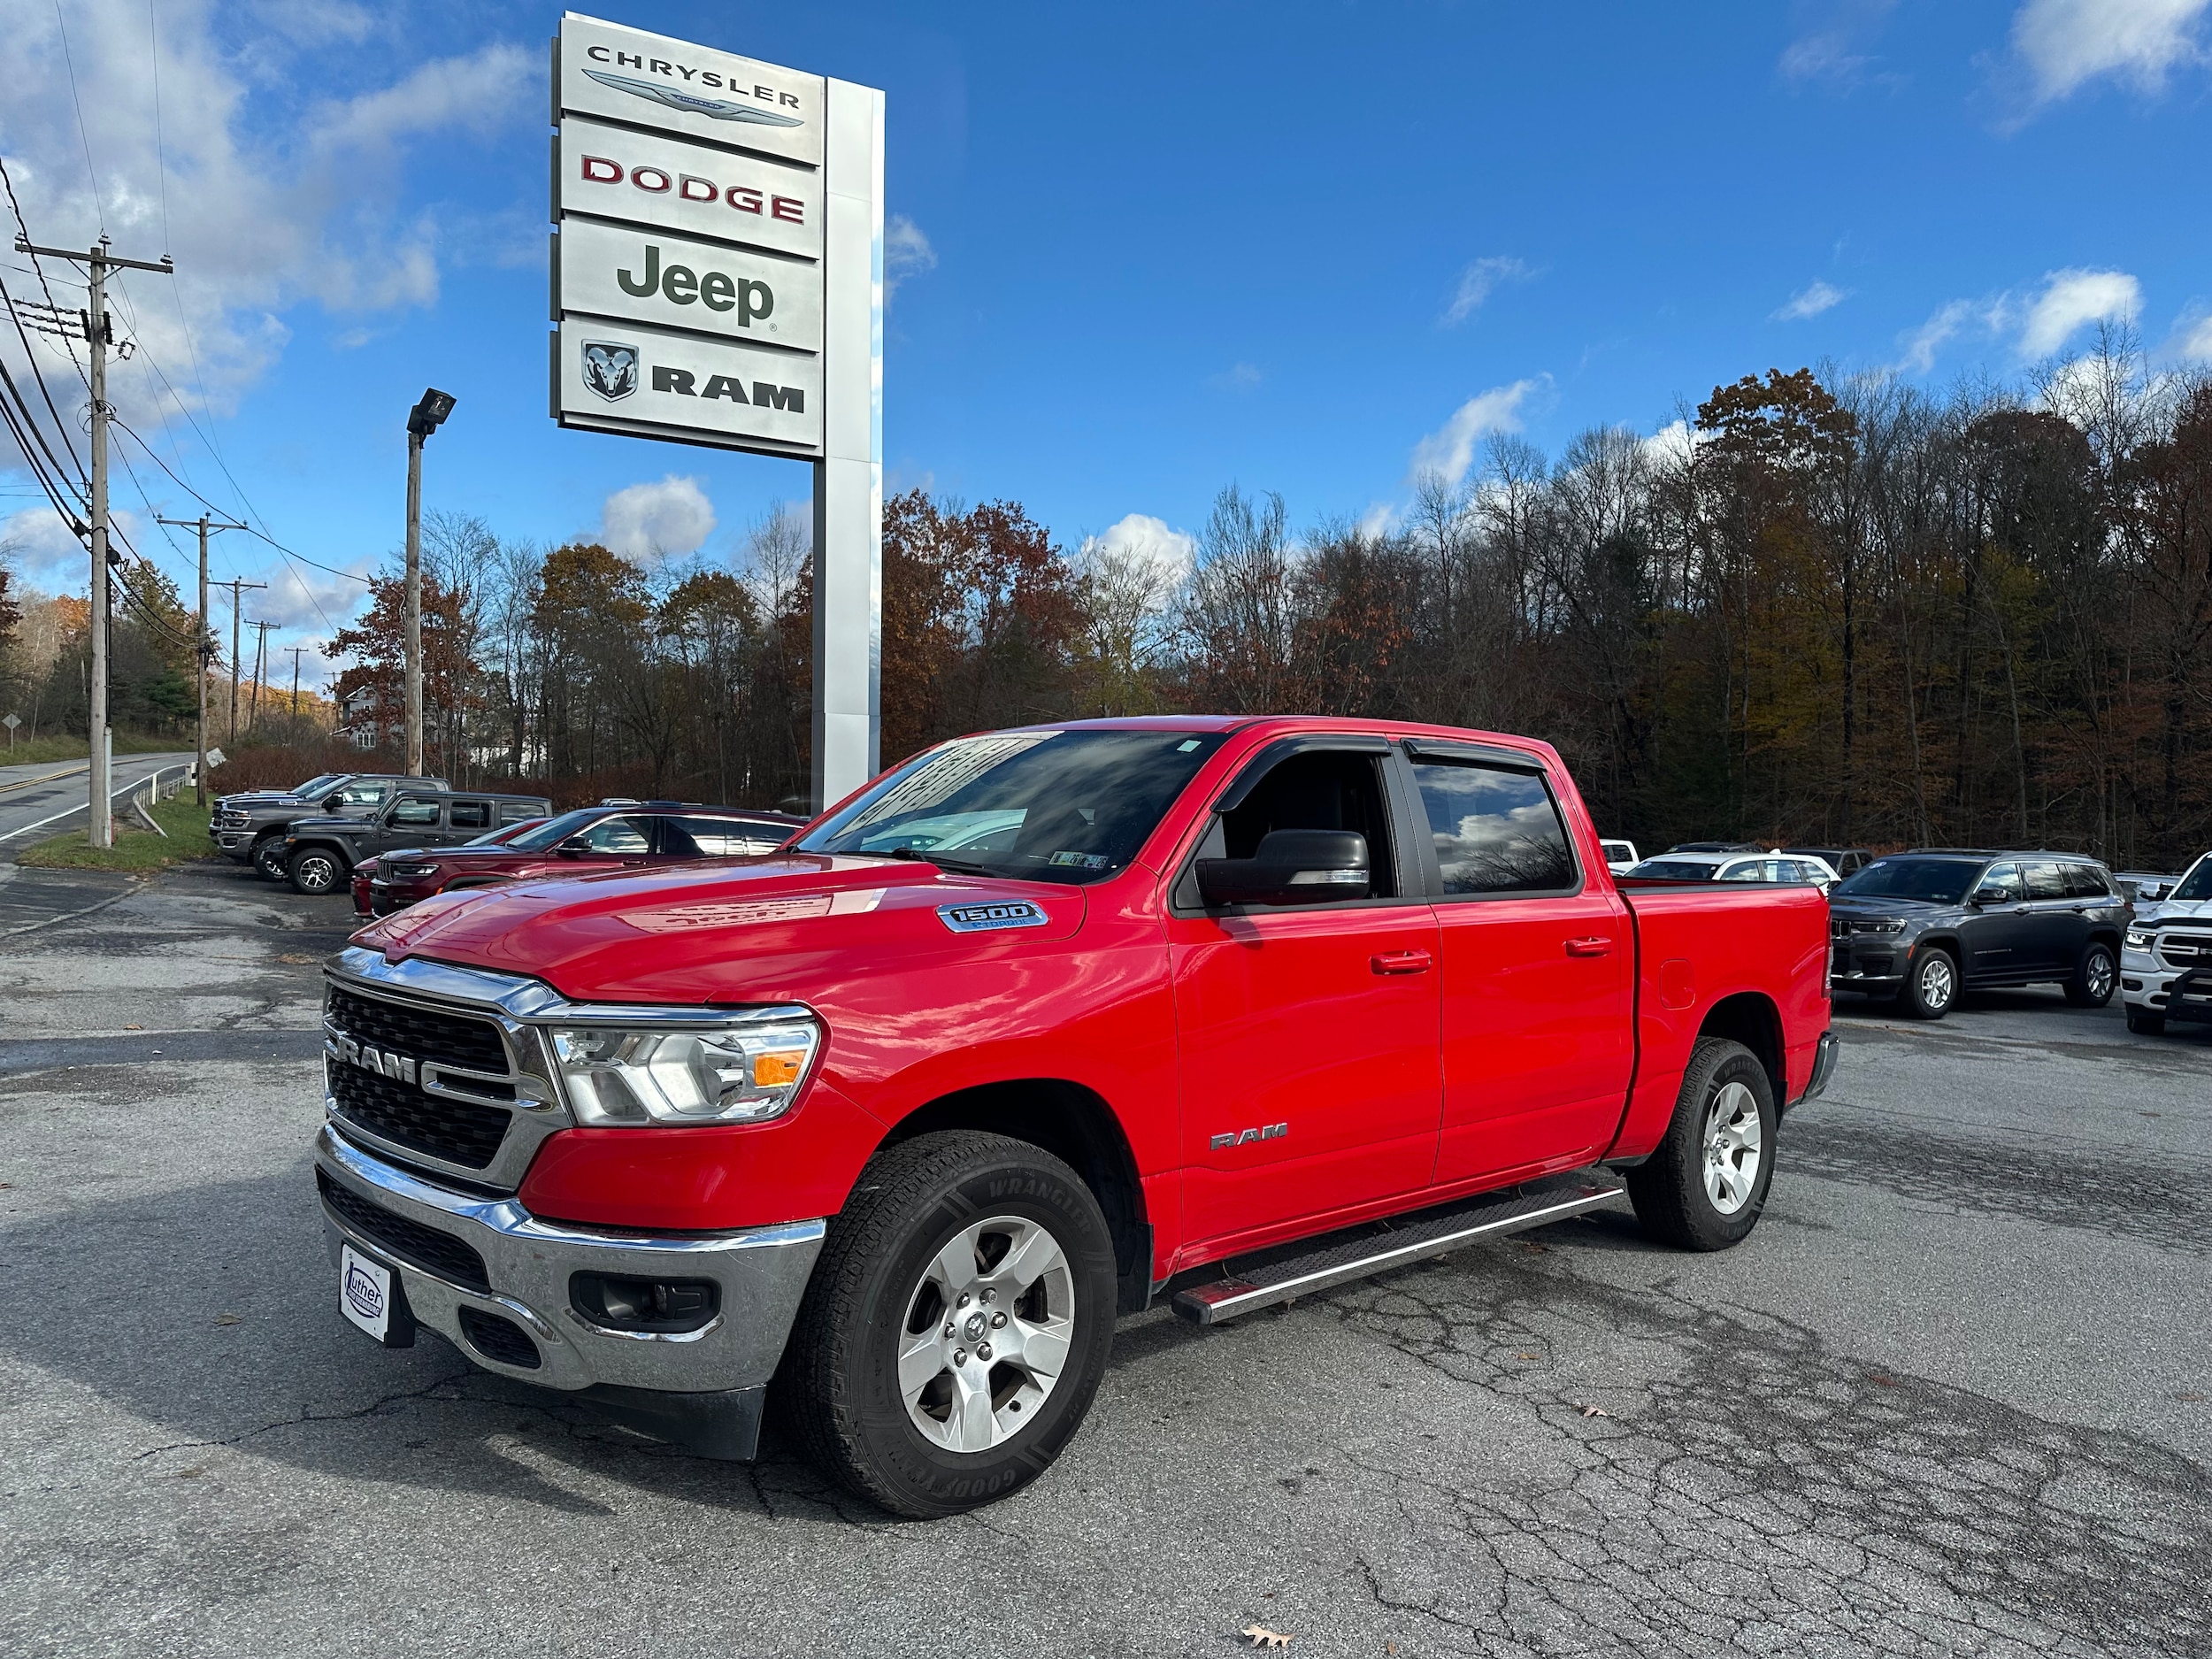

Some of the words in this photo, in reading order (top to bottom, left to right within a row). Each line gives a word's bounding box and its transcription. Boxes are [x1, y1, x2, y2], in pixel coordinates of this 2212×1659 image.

[587, 46, 800, 109] CHRYSLER
[676, 95, 720, 109] CHRYSLER
[580, 154, 805, 226] DODGE
[617, 244, 774, 328] Jeep
[652, 365, 804, 414] RAM
[955, 905, 1030, 923] 1500
[338, 1035, 416, 1086] RAM
[1210, 1122, 1287, 1151] RAM
[989, 1178, 1092, 1235] WRANGLER
